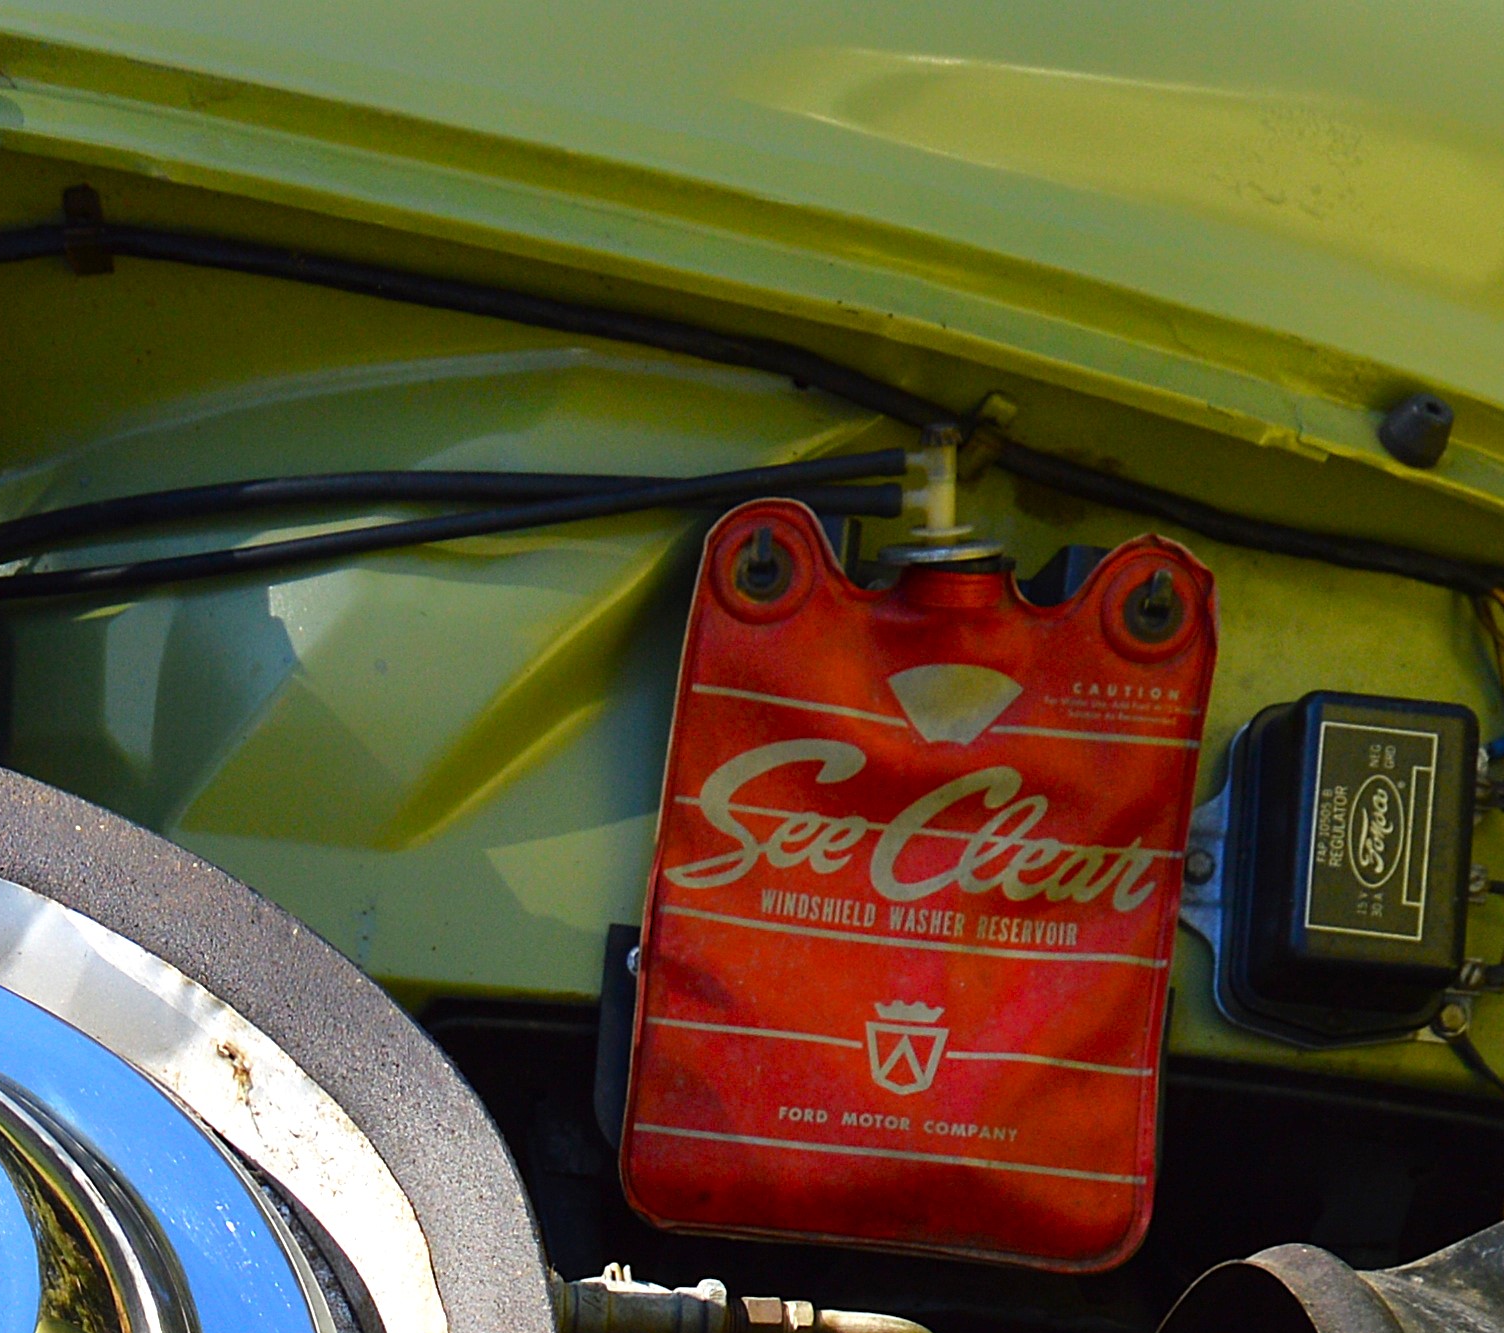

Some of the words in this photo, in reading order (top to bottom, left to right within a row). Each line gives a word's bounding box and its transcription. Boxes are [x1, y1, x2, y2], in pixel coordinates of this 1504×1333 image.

[1072, 681, 1180, 701] CAUTION
[666, 739, 872, 889] See
[869, 767, 1158, 912] Clear
[1316, 842, 1327, 862] FAP
[1328, 784, 1348, 867] REGULATOR
[1358, 788, 1394, 873] FoMoCo
[761, 890, 875, 927] WINDSHIELD
[890, 907, 964, 937] WASHER
[977, 917, 1078, 946] RESERVOIR
[778, 1107, 828, 1124] FORD
[842, 1113, 910, 1132] MOTOR
[923, 1121, 1019, 1142] COMPANY
